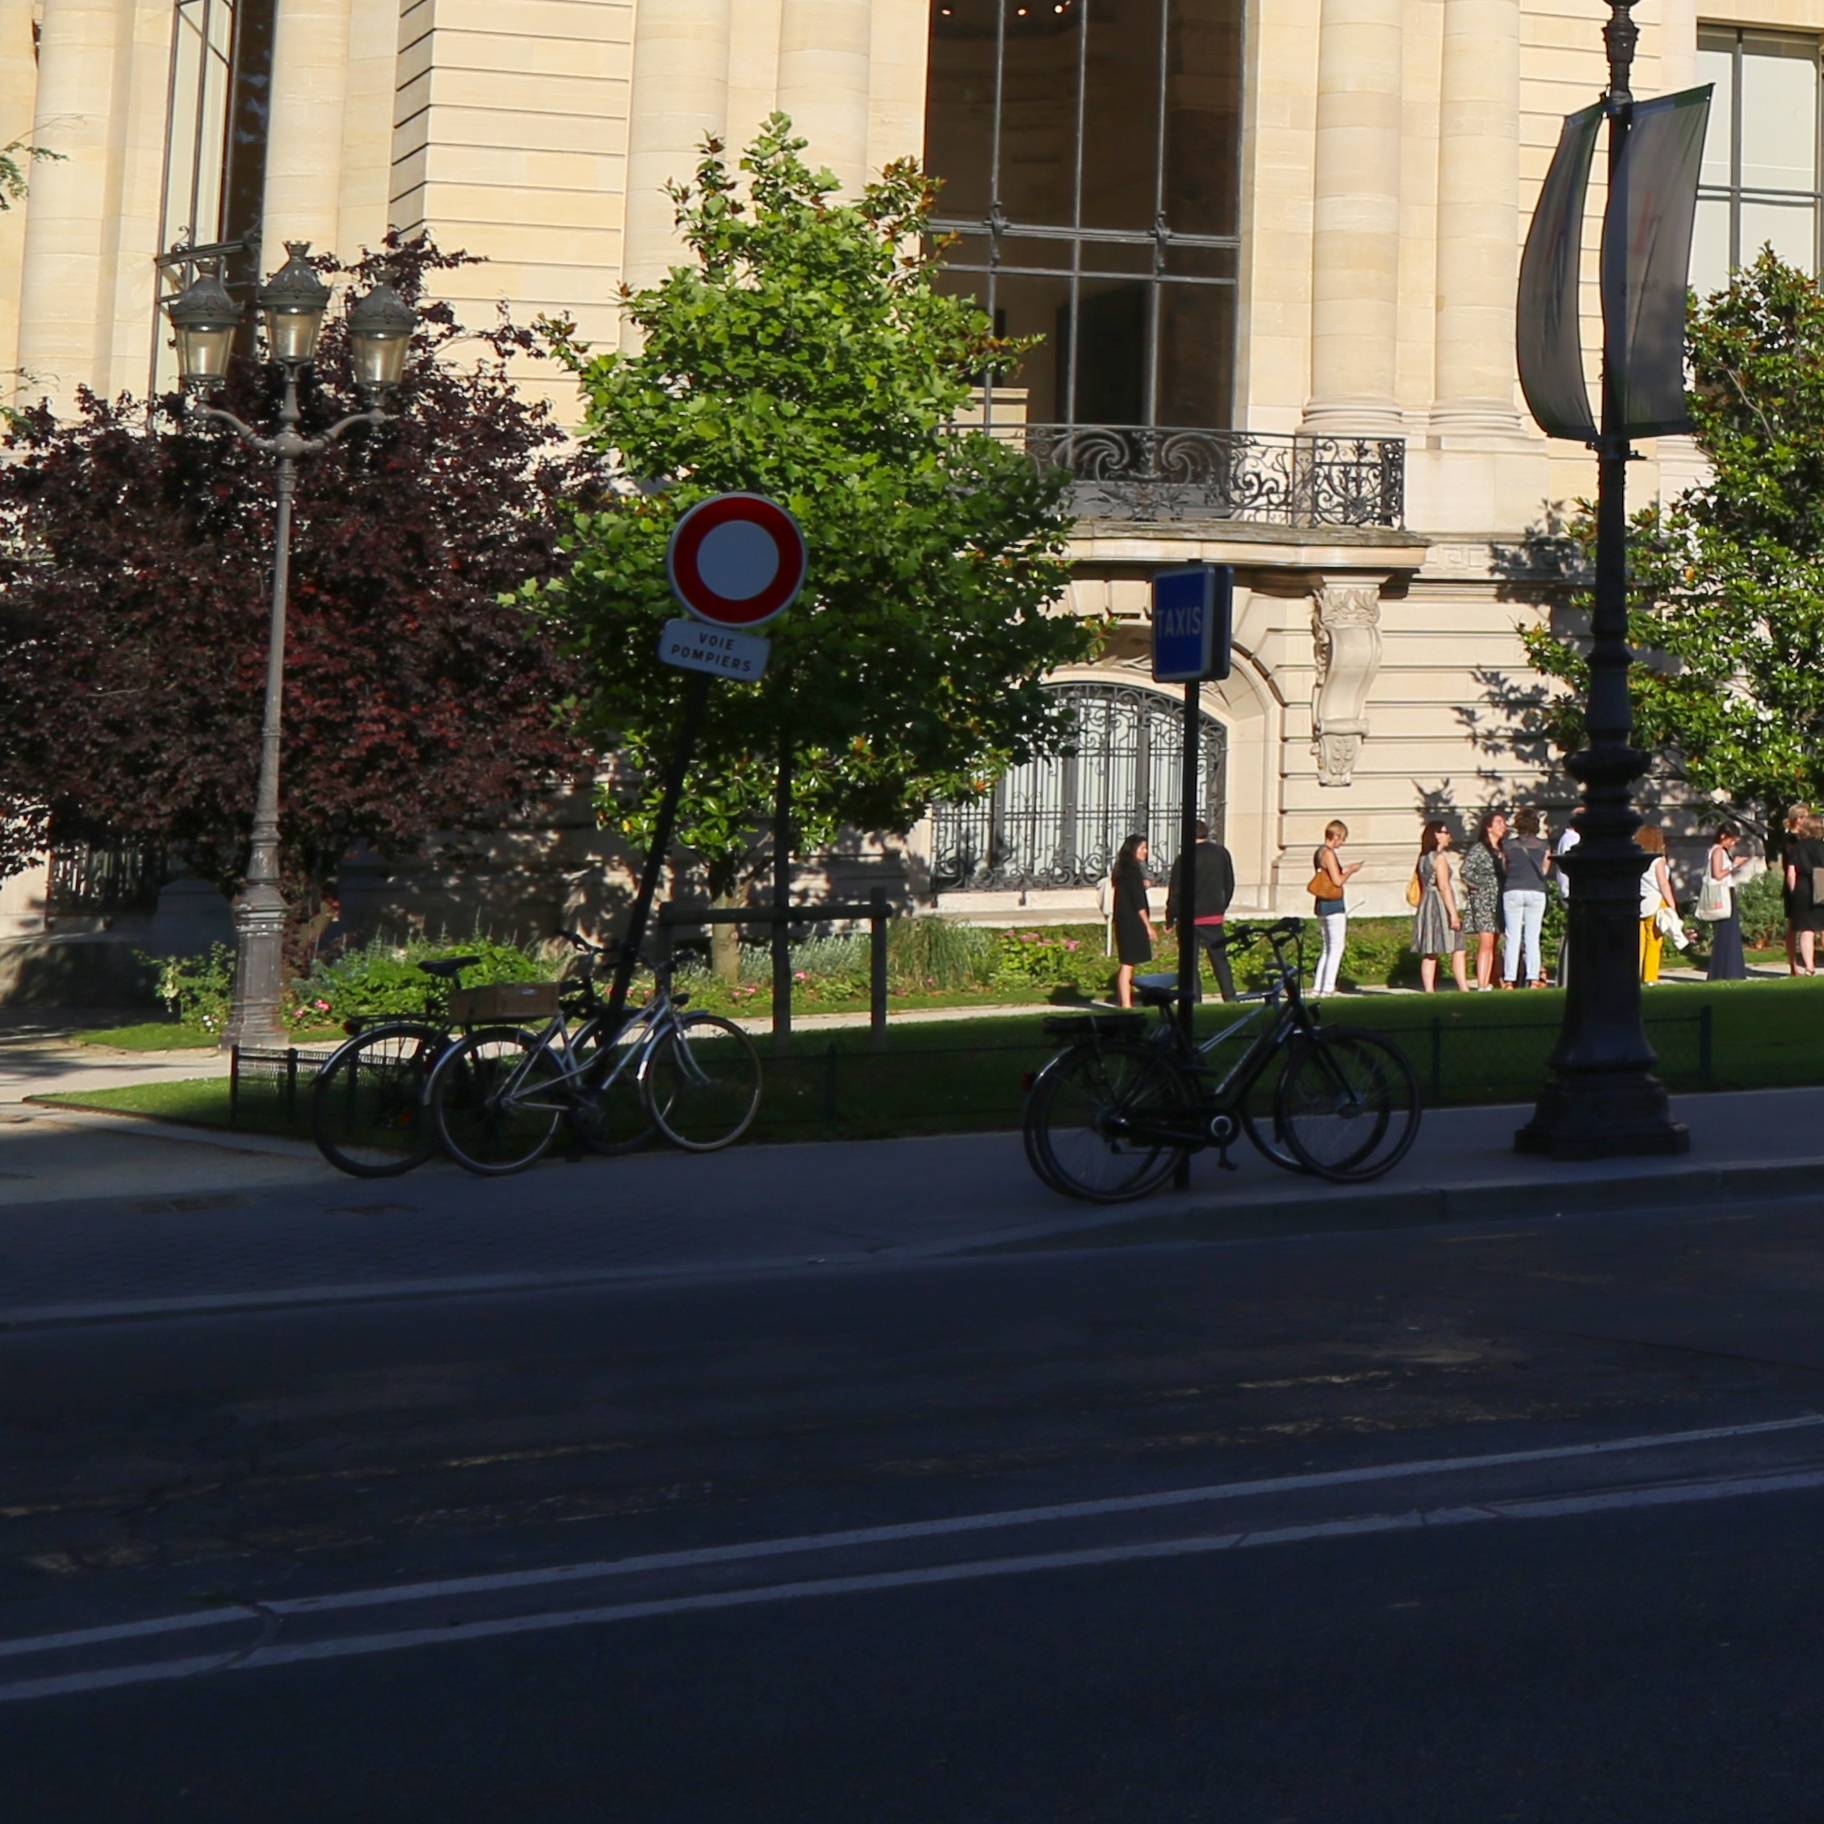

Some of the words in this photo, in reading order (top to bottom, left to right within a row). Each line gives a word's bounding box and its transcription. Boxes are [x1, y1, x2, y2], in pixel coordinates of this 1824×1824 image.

[1156, 606, 1202, 639] TAXIS
[699, 632, 736, 651] VOIE
[671, 644, 753, 673] POMPIERS
